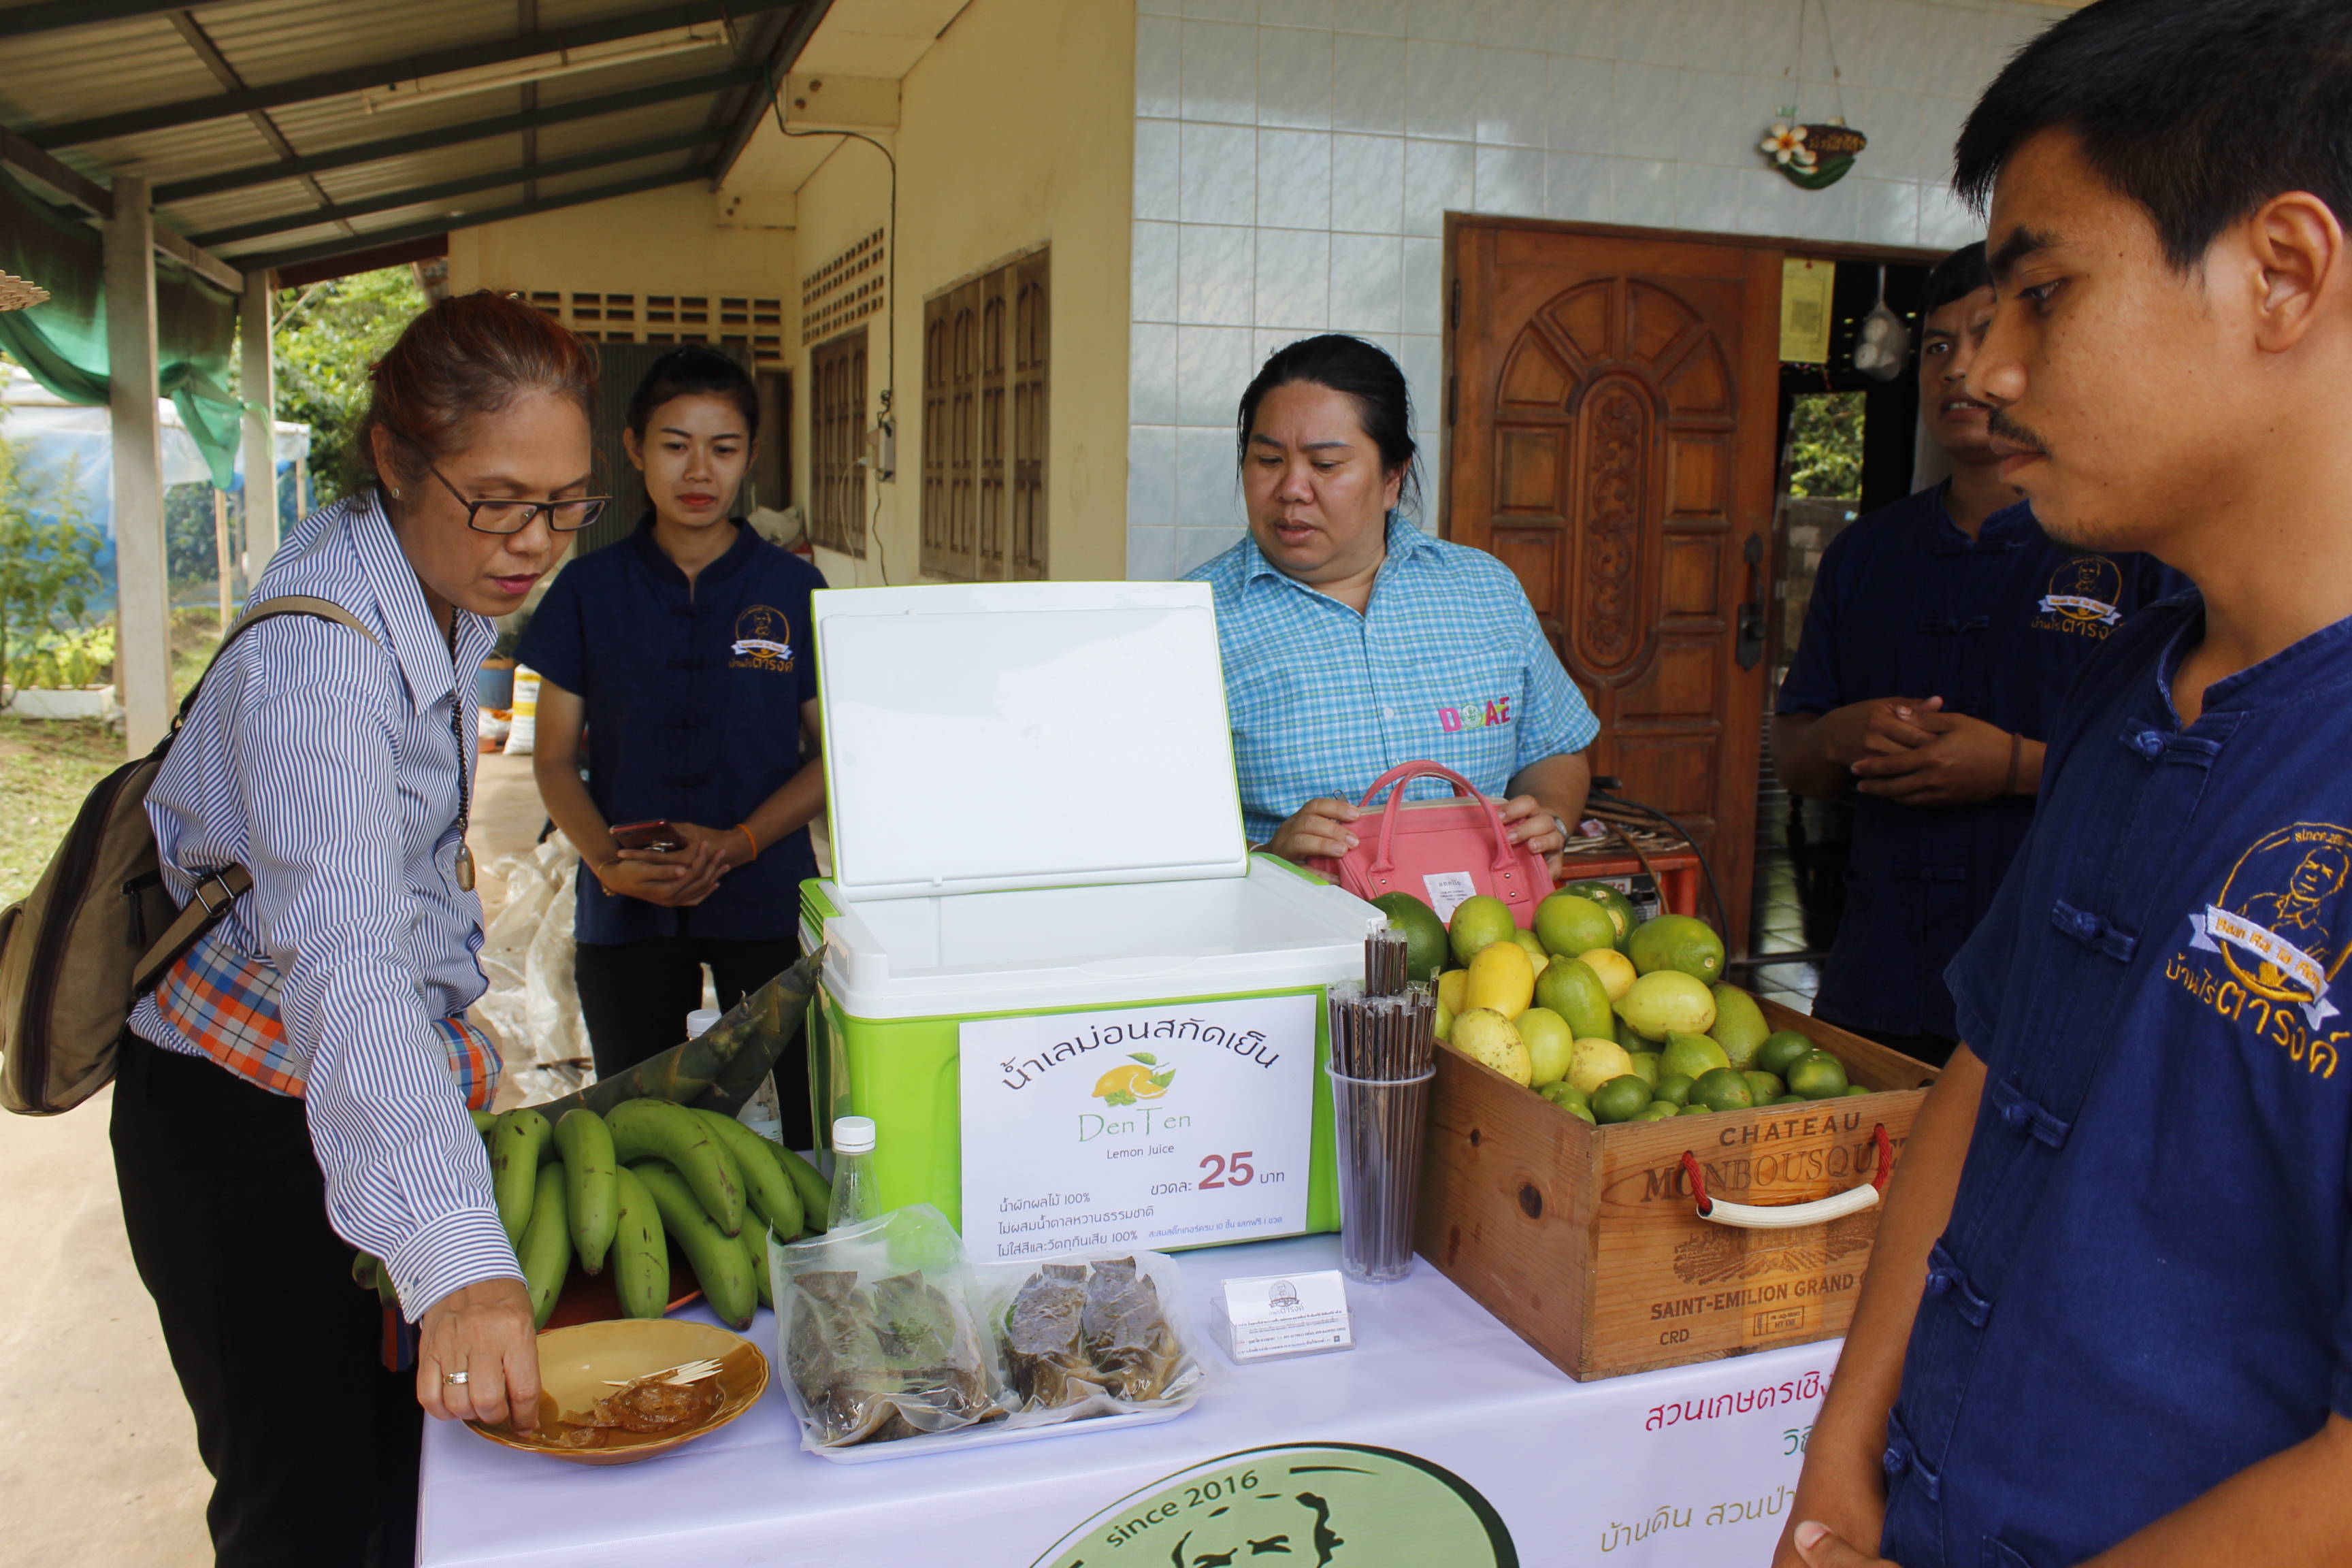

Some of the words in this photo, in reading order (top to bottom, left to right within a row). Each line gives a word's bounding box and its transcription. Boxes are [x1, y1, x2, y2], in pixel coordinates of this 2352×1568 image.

[1000, 1017, 1280, 1090] น้ำเลม่อนสกัดเย็น
[1107, 1148, 1143, 1160] Lemon
[1148, 1143, 1175, 1156] Juice
[1719, 1111, 1862, 1147] CHATEAU
[1151, 1181, 1192, 1196] ขวดละ
[1198, 1151, 1254, 1190] 25
[1260, 1171, 1285, 1184] บาท
[1640, 1137, 1908, 1203] MONBOUSQU
[1000, 1193, 1060, 1213] น้ำผักผลไม้
[1064, 1192, 1090, 1205] 100%
[1112, 1230, 1138, 1242] 100%
[1650, 1284, 1788, 1320] SAINT-EMILION
[1794, 1273, 1855, 1297] GRAND
[1659, 1328, 1690, 1346] CRD
[1106, 1500, 1179, 1548] since
[1183, 1469, 1260, 1509] 2016
[1601, 1505, 1693, 1552] บ้านดิน
